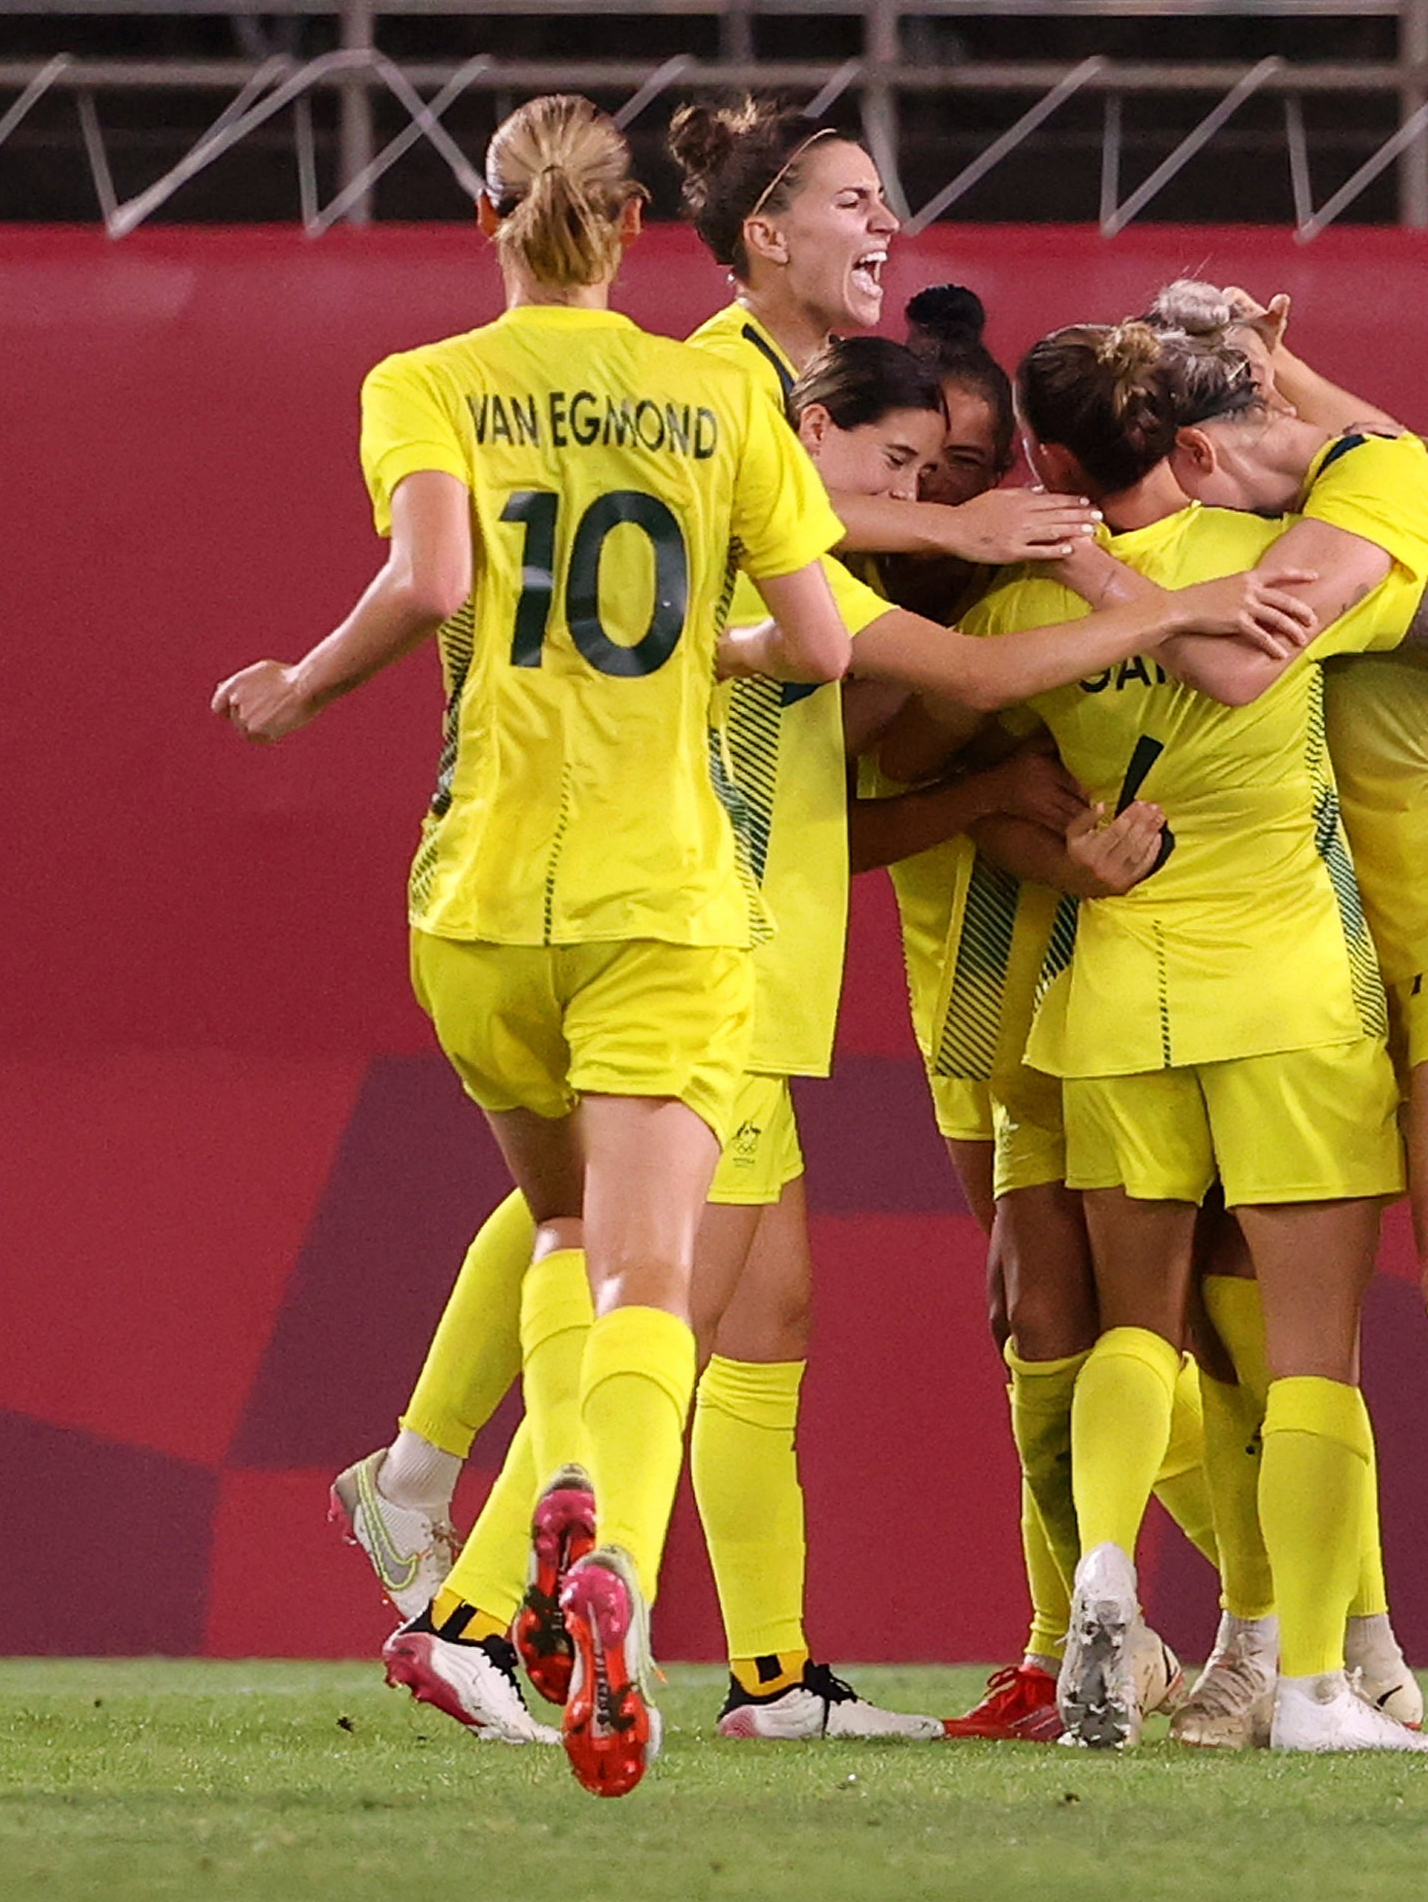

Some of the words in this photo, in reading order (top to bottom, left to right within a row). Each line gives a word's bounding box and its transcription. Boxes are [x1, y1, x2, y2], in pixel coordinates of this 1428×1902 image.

[466, 393, 540, 447] VAN
[550, 389, 719, 460] EGMOND
[500, 490, 688, 677] 10
